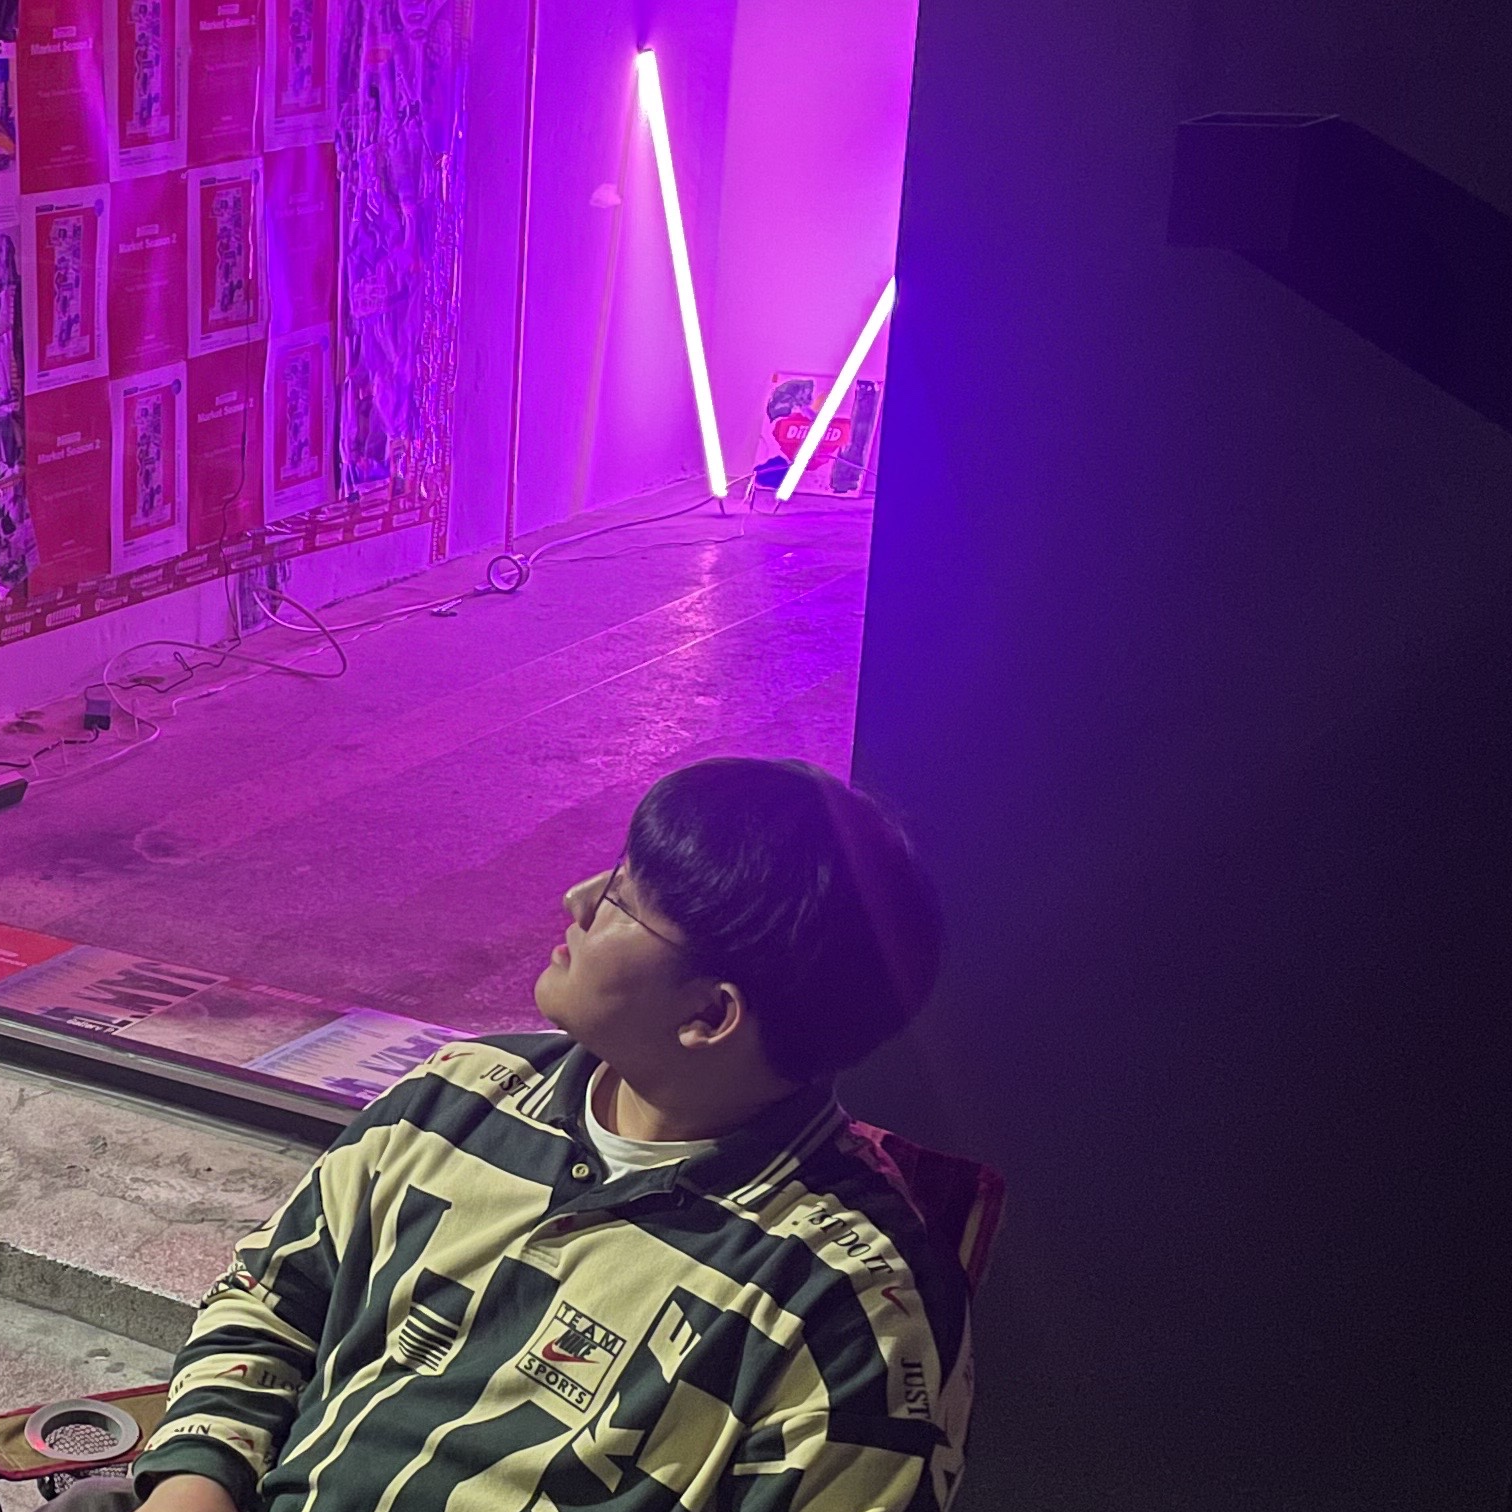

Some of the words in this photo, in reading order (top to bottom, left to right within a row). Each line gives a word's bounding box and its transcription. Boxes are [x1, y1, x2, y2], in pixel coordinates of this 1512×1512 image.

[199, 19, 224, 31] Market
[226, 17, 250, 29] Season
[251, 14, 257, 25] 2
[119, 241, 144, 254] Market
[145, 236, 171, 249] Season
[172, 232, 178, 244] 2
[197, 408, 223, 423] Market
[248, 397, 255, 408] 2
[38, 448, 65, 465] Market
[66, 440, 95, 457] Season
[95, 438, 102, 453] 2
[480, 1064, 531, 1098] JUST
[834, 1229, 873, 1258] DO
[859, 1252, 894, 1276] IT
[553, 1328, 599, 1361] NIKE
[558, 1305, 618, 1354] TEAM
[523, 1357, 588, 1405] SPORTS
[900, 1356, 932, 1421] JUST
